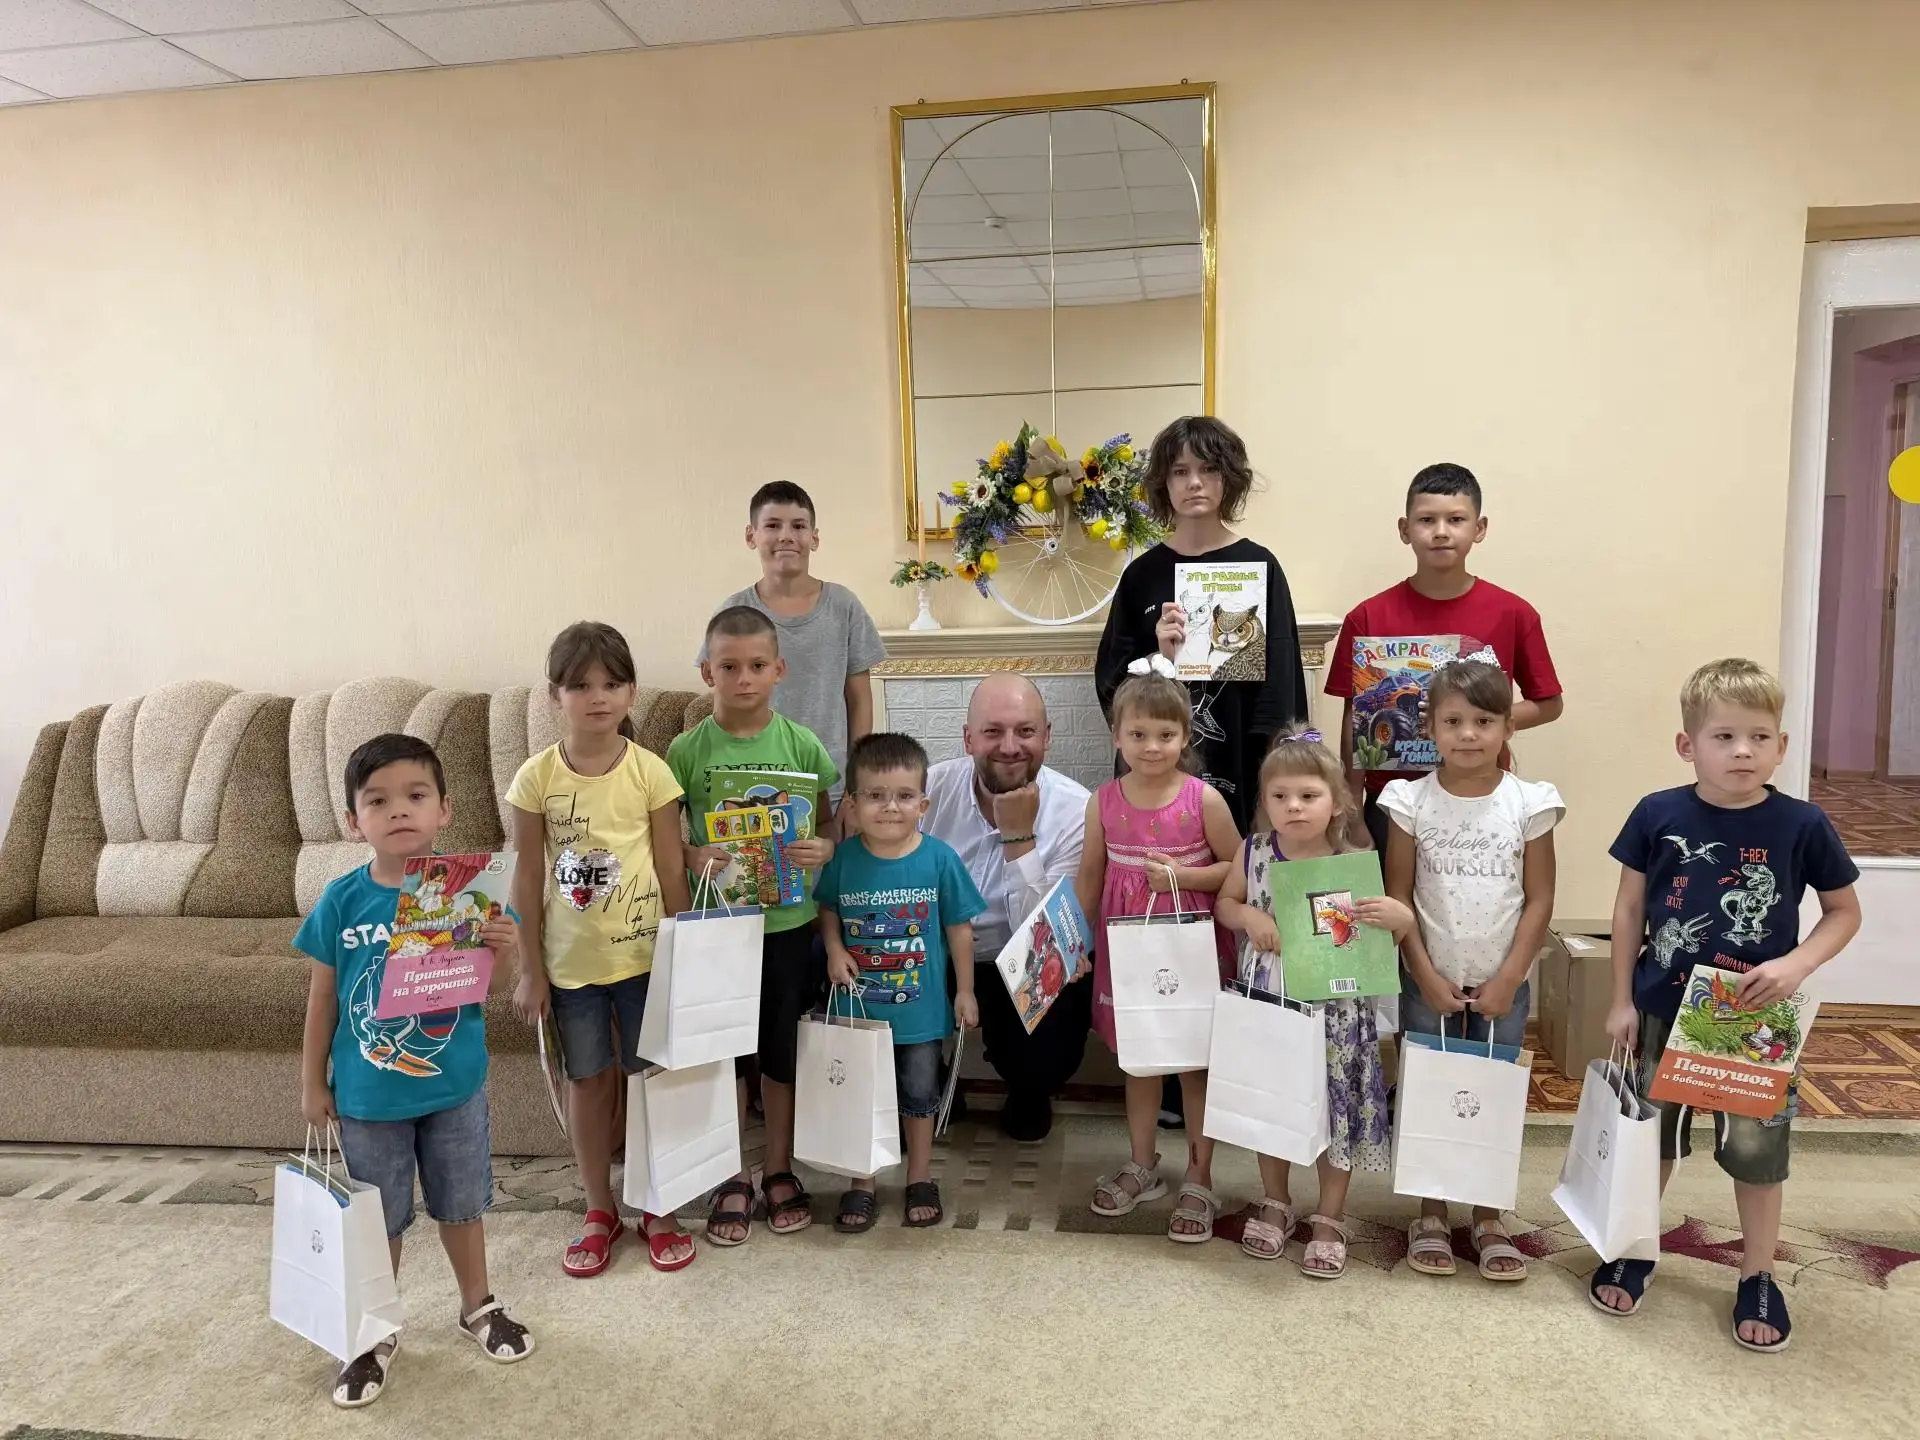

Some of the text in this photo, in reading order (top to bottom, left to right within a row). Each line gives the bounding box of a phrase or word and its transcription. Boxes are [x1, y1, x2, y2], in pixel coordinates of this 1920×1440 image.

[1419, 827, 1514, 851] Believe in
[1739, 848, 1768, 864] T-REX
[560, 867, 608, 886] LOVE
[1424, 858, 1513, 877] YOURSELF
[870, 894, 938, 906] CHAMPIONS
[342, 922, 394, 949] STA
[404, 964, 474, 984] Принцесса
[393, 987, 409, 997] на
[1674, 1057, 1776, 1088] Петушок
